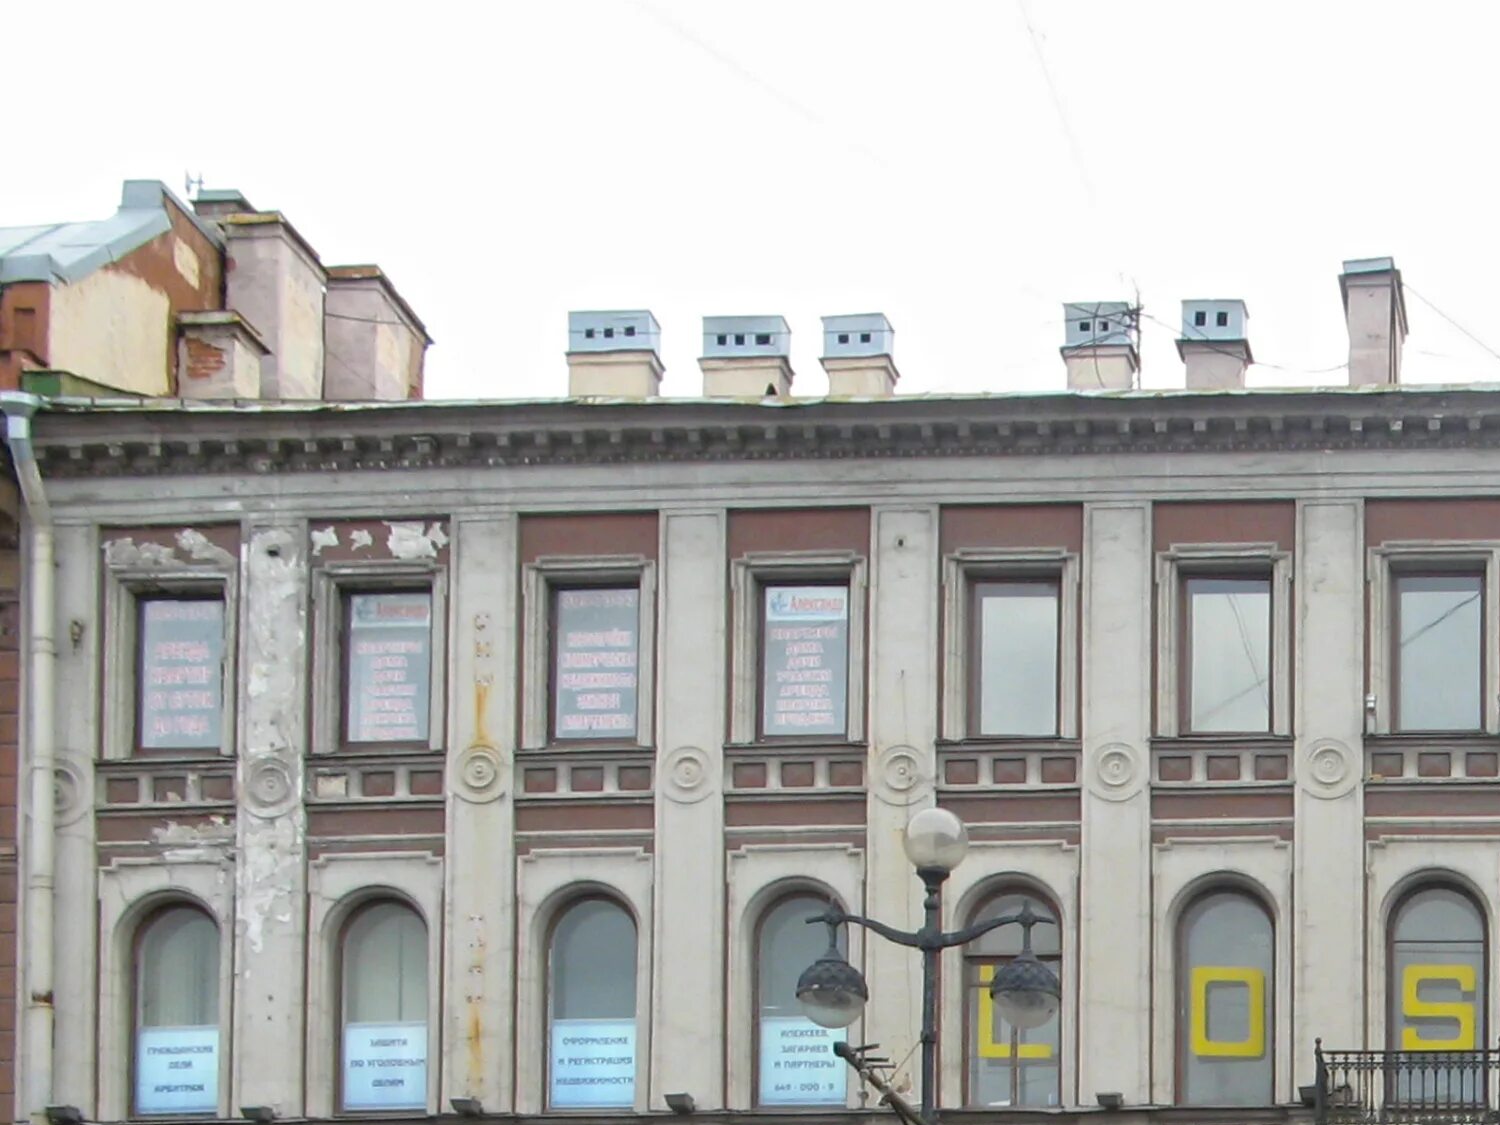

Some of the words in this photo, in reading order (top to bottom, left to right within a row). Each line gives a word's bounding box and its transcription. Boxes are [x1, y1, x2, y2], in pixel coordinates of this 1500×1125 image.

[562, 1037, 628, 1046] ОФОРМЛЕНИЕ
[567, 1056, 633, 1066] РЕГИСТРАЦИЯ
[784, 1060, 835, 1069] ПАРТНЕРЫ
[555, 1076, 634, 1086] НЕДВИЖИМОСТИ
